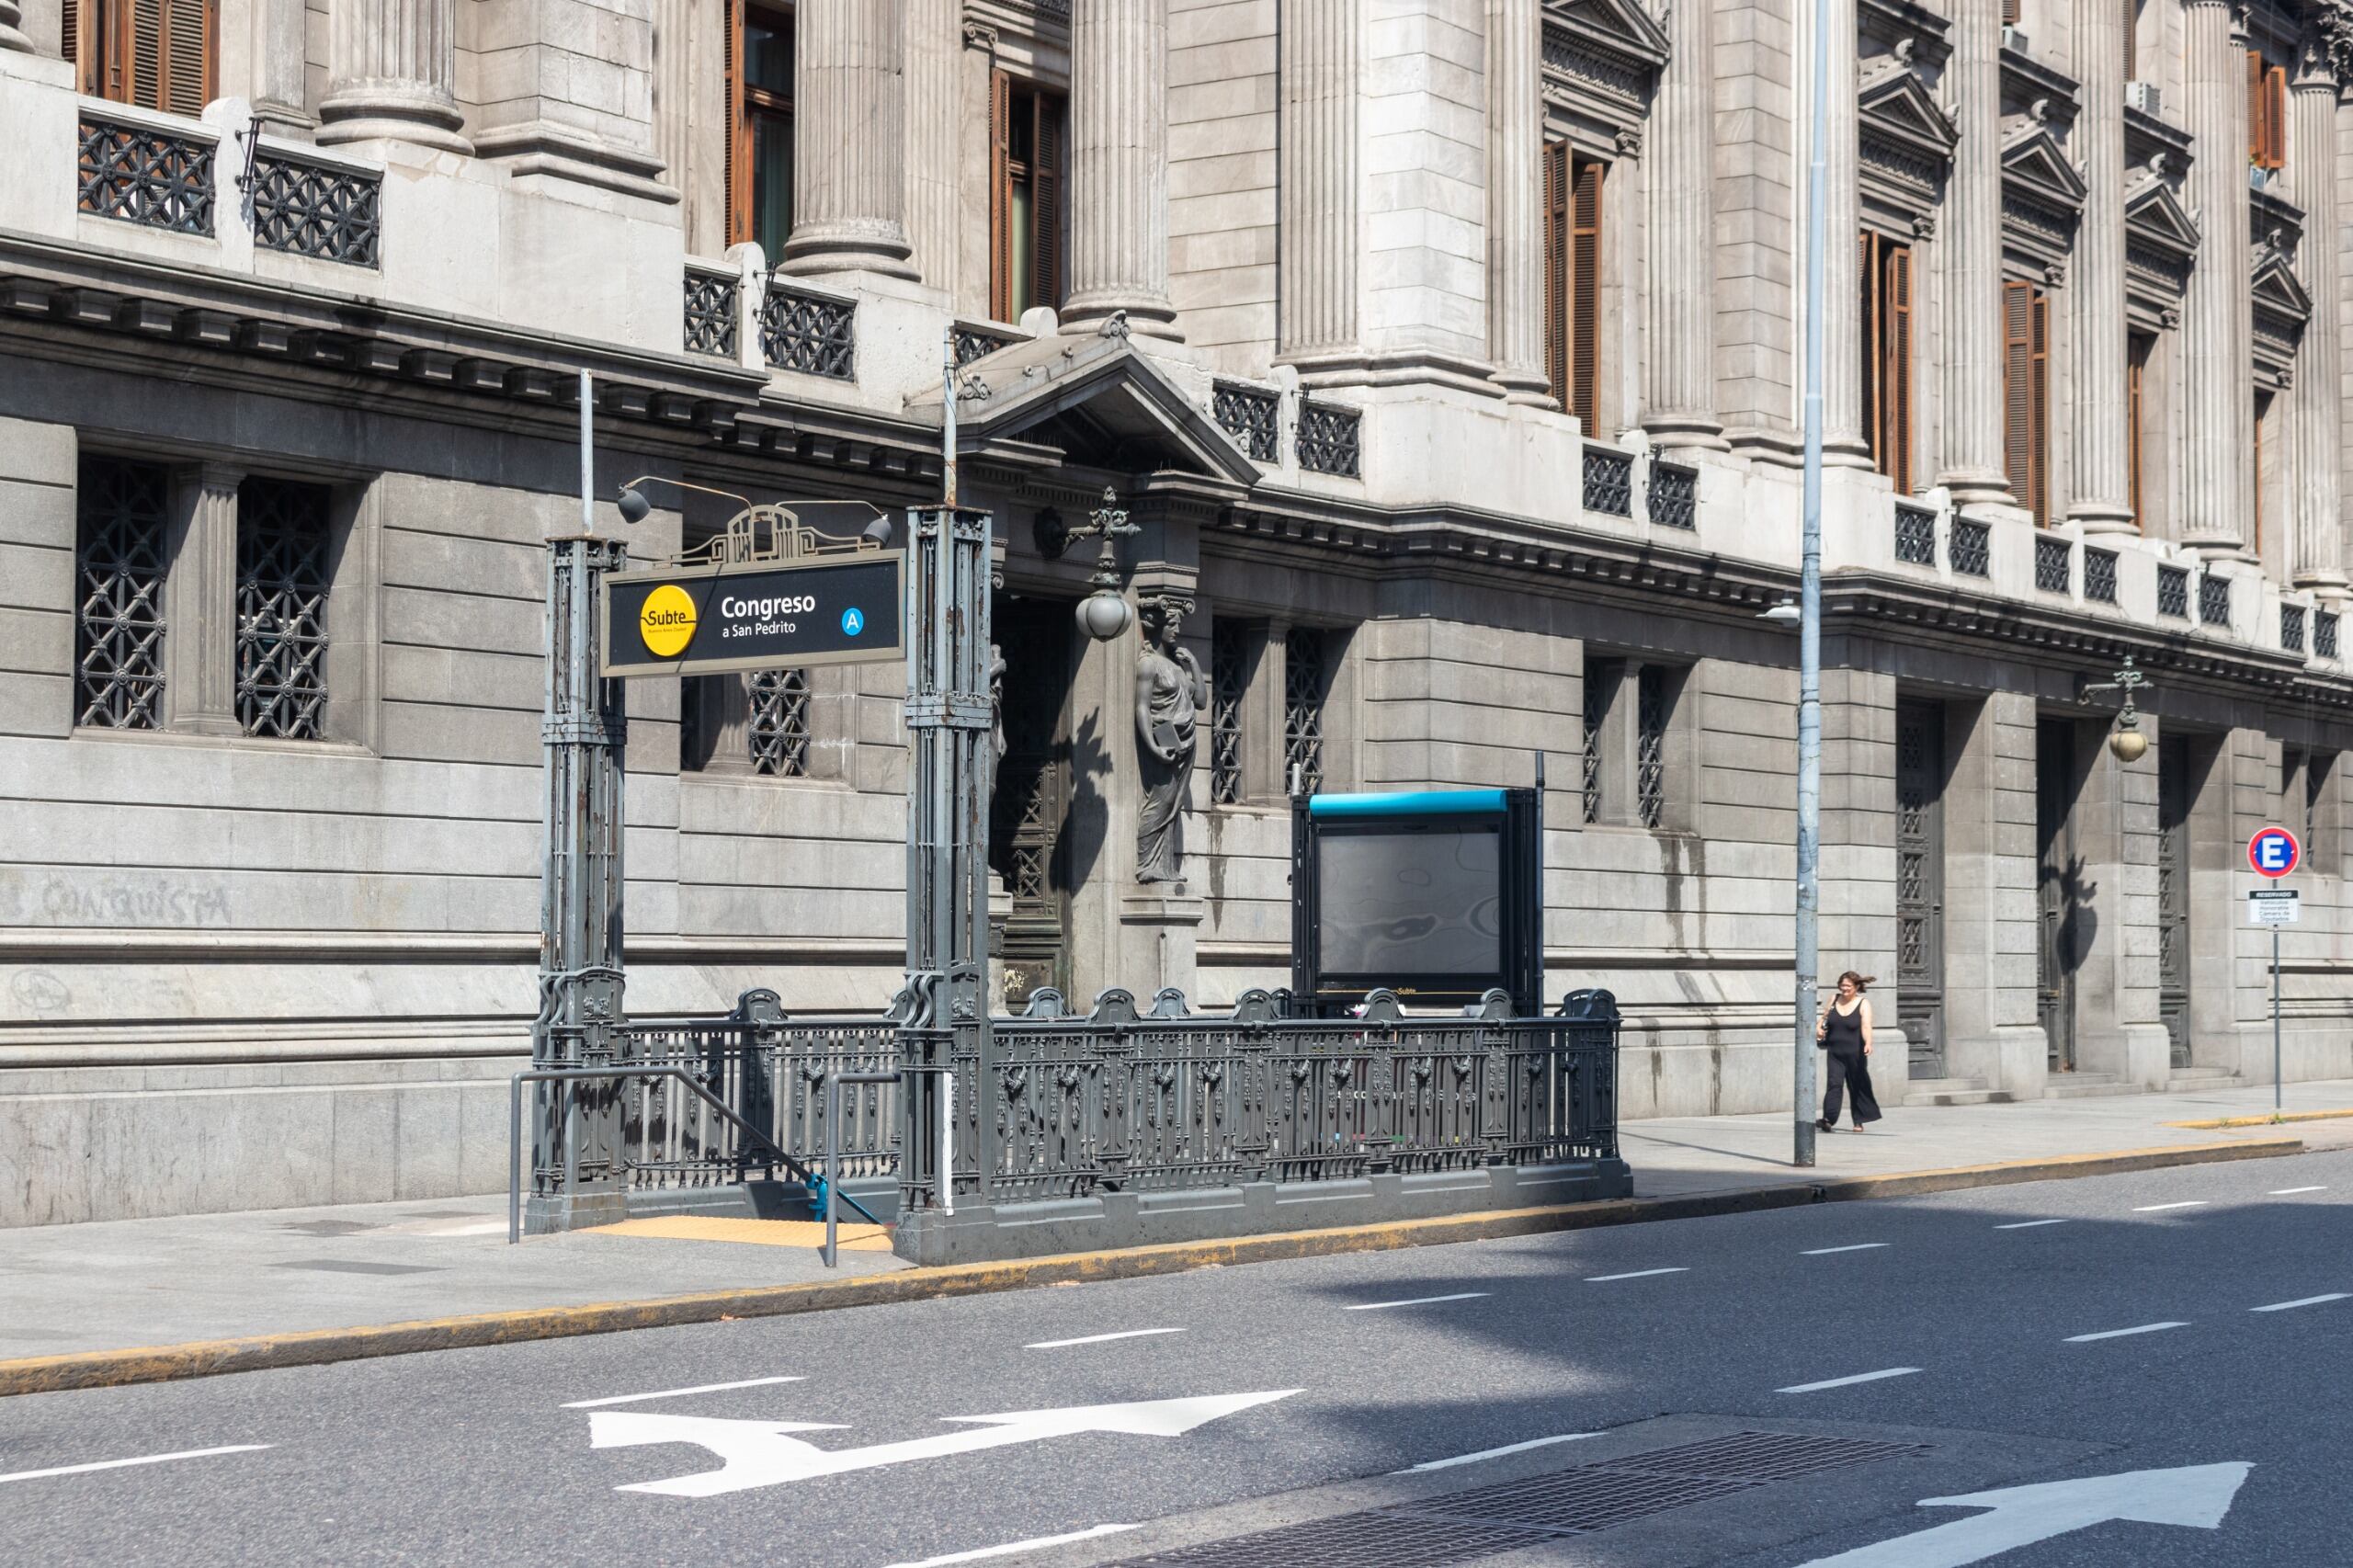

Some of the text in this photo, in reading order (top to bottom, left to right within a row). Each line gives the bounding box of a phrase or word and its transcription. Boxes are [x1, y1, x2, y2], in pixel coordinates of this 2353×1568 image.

[648, 609, 687, 626] Subte
[721, 596, 816, 621] Congreso
[722, 621, 796, 638] a San Pedrito
[846, 612, 859, 630] A
[2262, 837, 2285, 869] E
